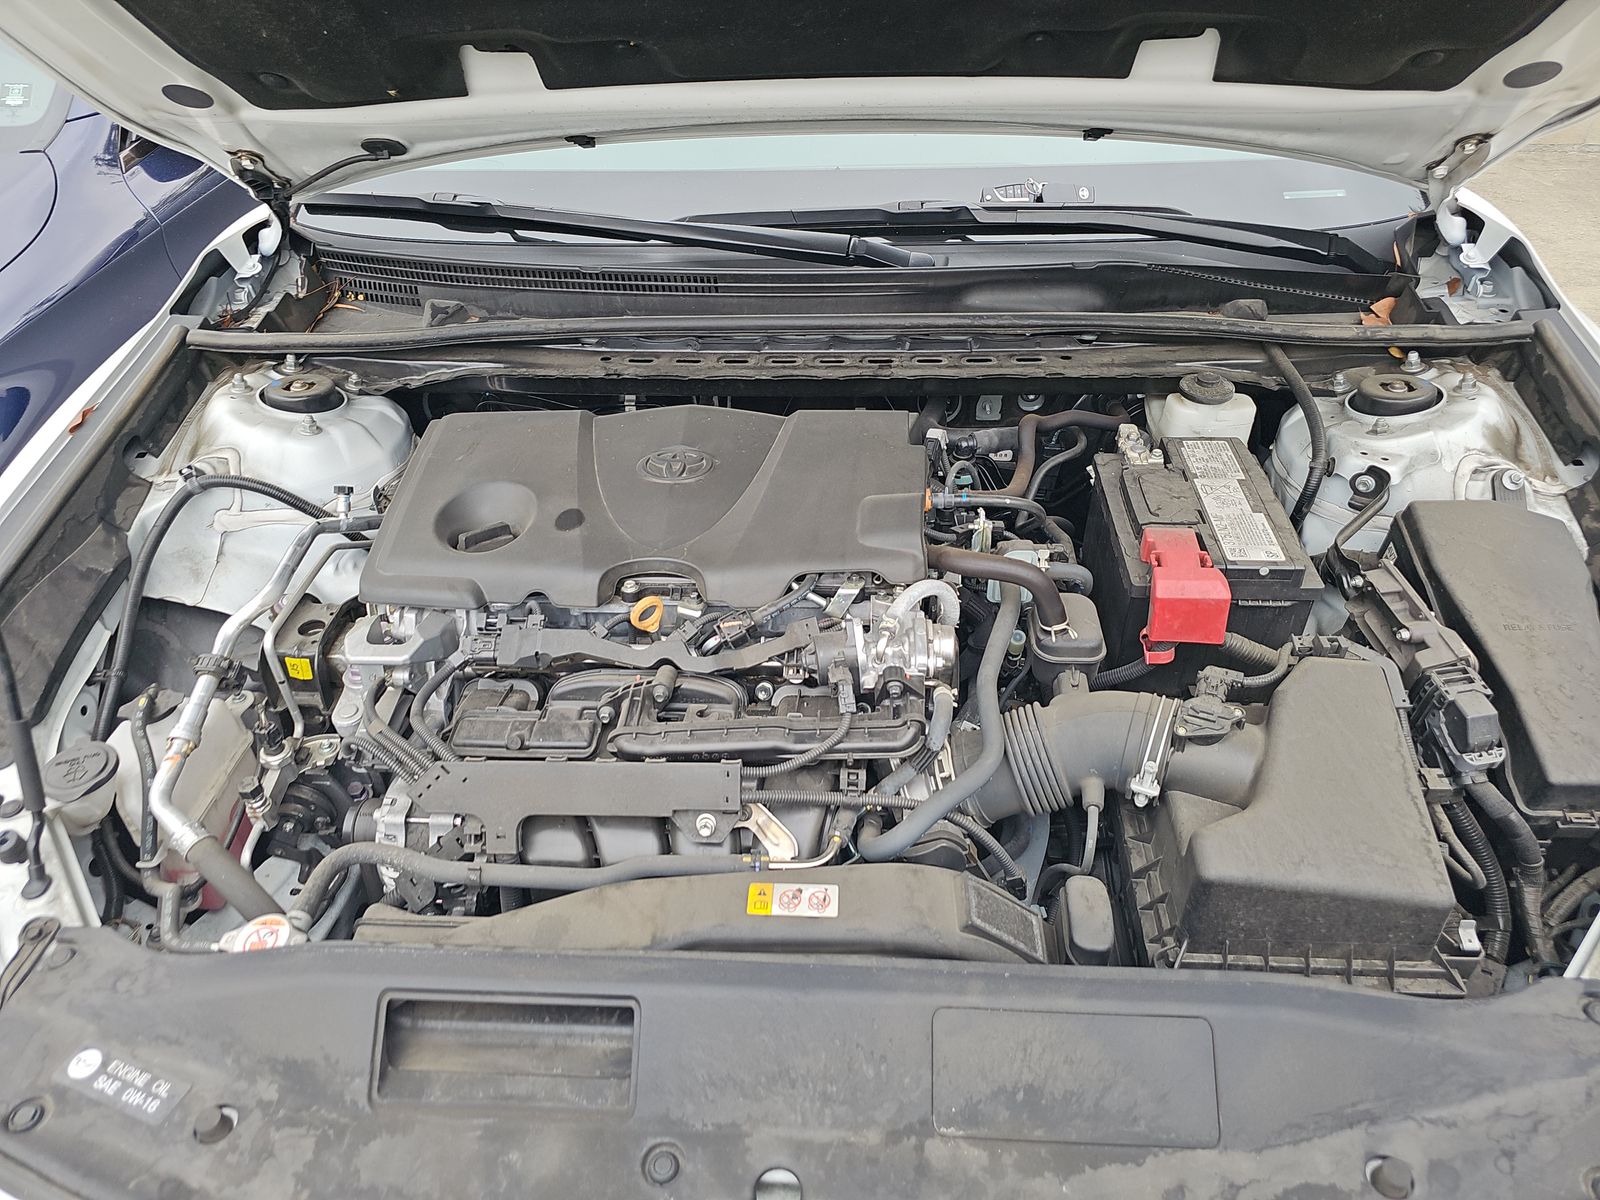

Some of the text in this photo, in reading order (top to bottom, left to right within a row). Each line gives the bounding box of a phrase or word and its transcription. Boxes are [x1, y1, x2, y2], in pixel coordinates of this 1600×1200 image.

[93, 1074, 122, 1096] SAE
[106, 1058, 172, 1098] ENGINE OIL
